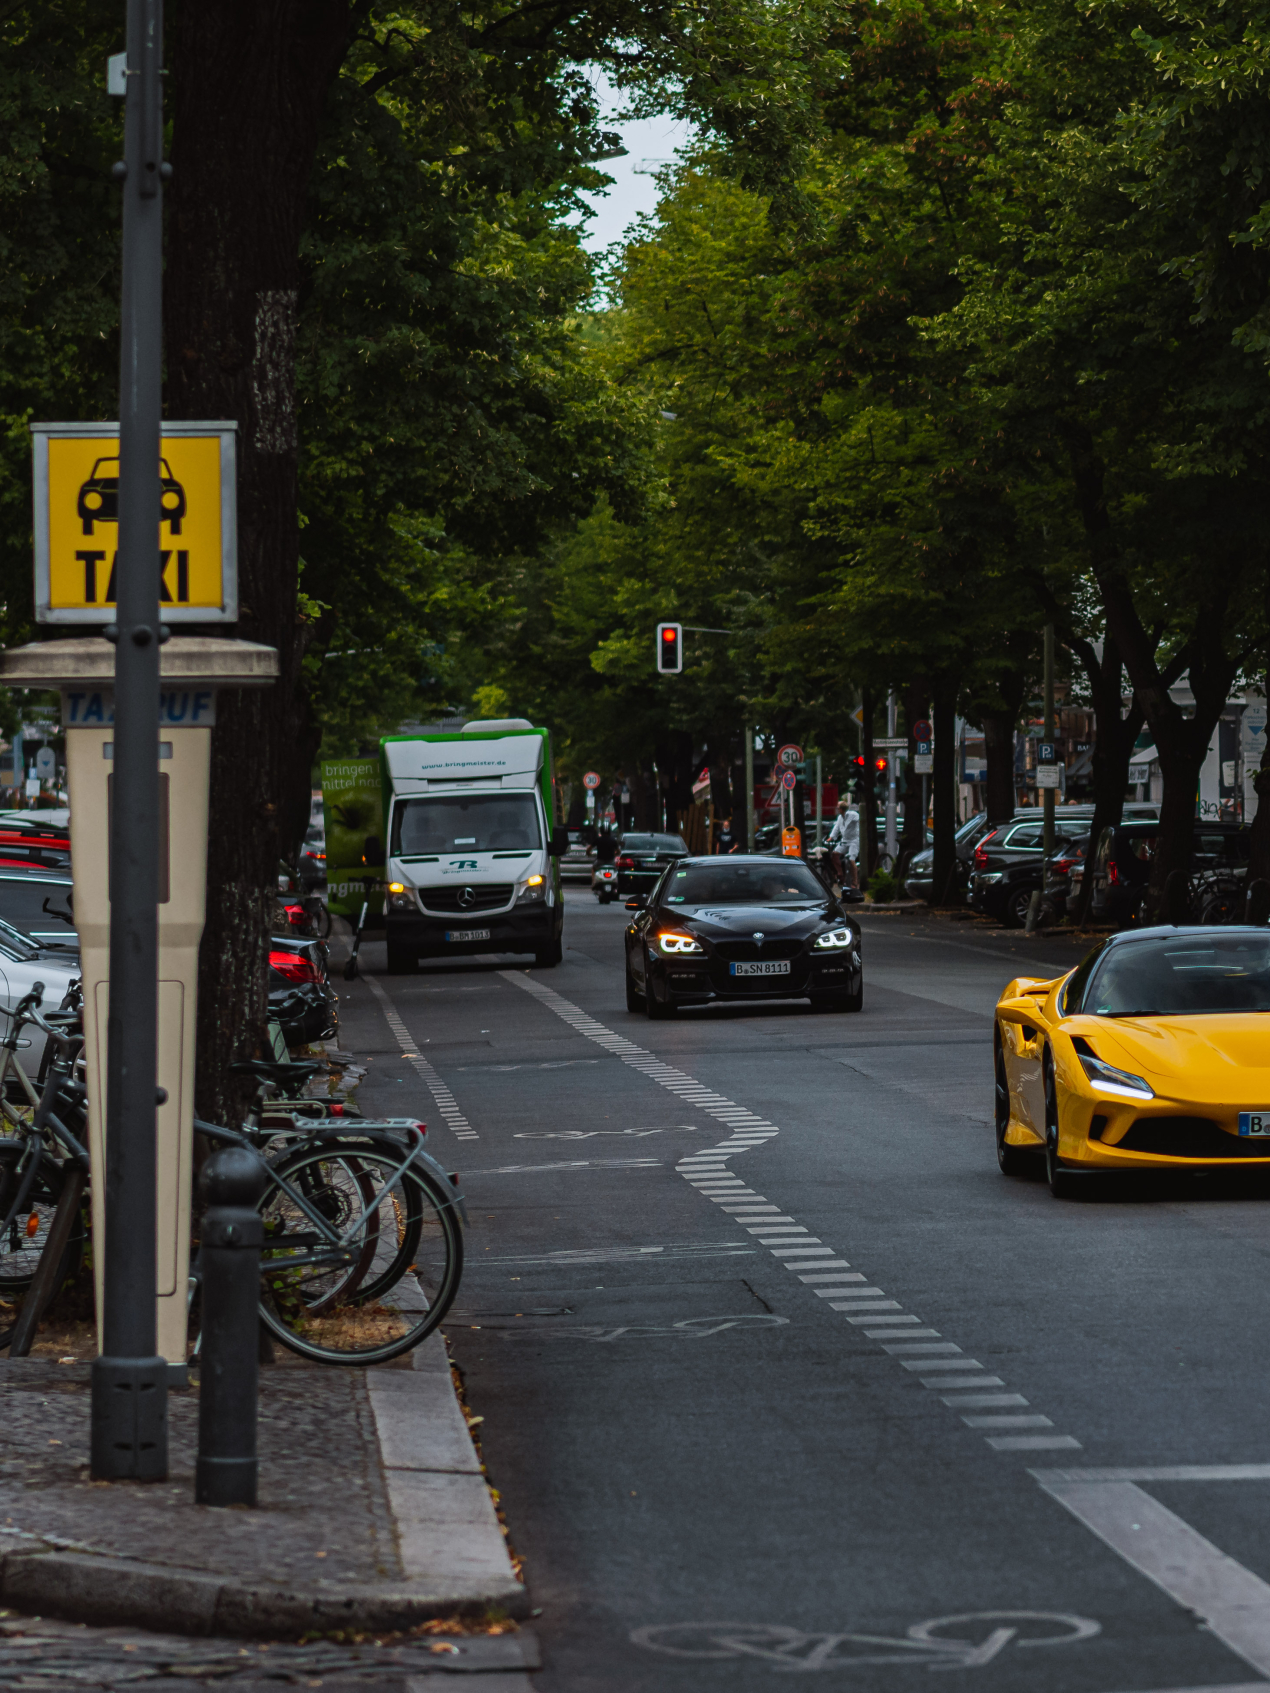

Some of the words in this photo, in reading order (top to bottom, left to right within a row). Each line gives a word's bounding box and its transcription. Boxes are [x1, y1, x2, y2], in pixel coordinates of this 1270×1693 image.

[75, 551, 188, 602] TI
[920, 744, 927, 754] P
[1042, 746, 1051, 758] P
[784, 752, 798, 764] 30
[326, 764, 372, 777] bringen
[587, 775, 597, 784] 30
[460, 932, 470, 940] BM
[470, 930, 490, 940] 1013
[736, 964, 743, 974] B
[750, 964, 763, 974] SN
[764, 963, 788, 973] 8111
[1250, 1116, 1262, 1132] B
